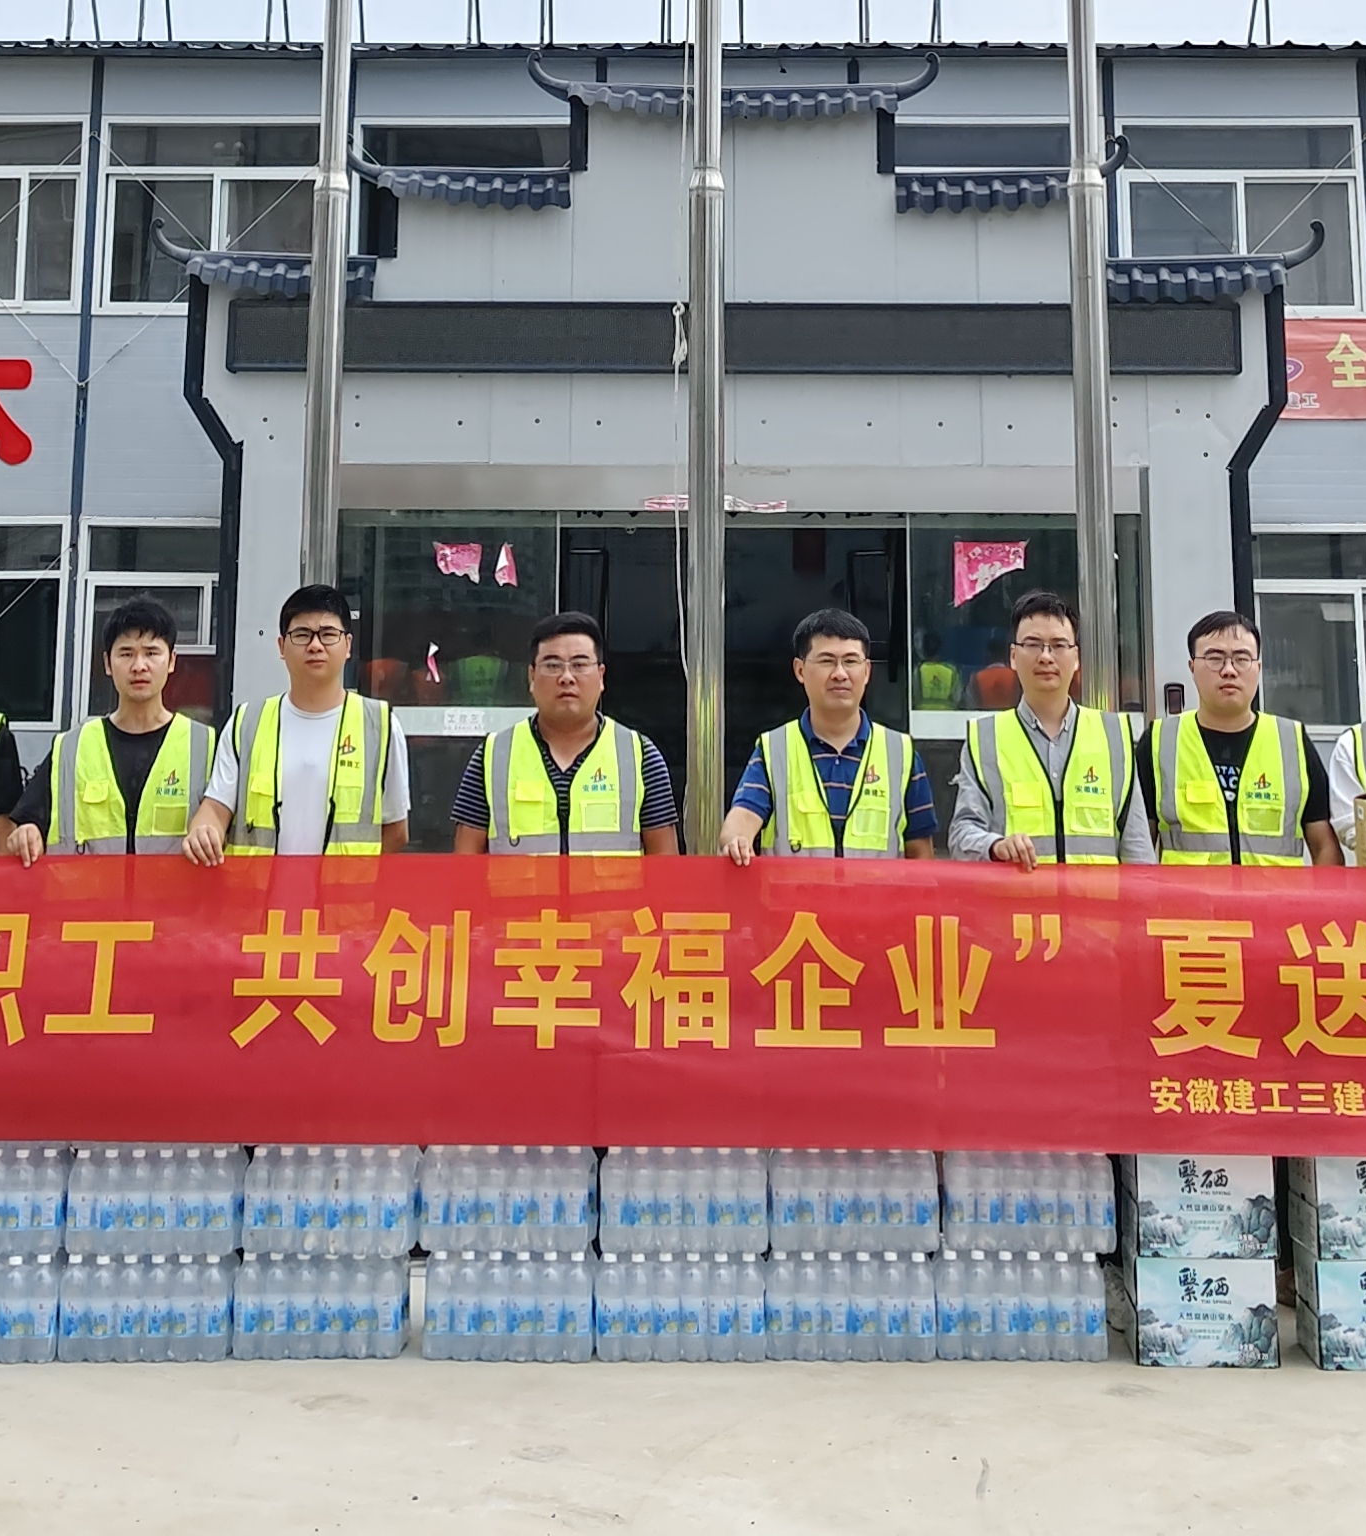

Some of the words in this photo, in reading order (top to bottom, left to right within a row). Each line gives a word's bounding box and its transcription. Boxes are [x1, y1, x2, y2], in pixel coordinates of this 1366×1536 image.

[229, 907, 1063, 1050] 共创幸福企业”
